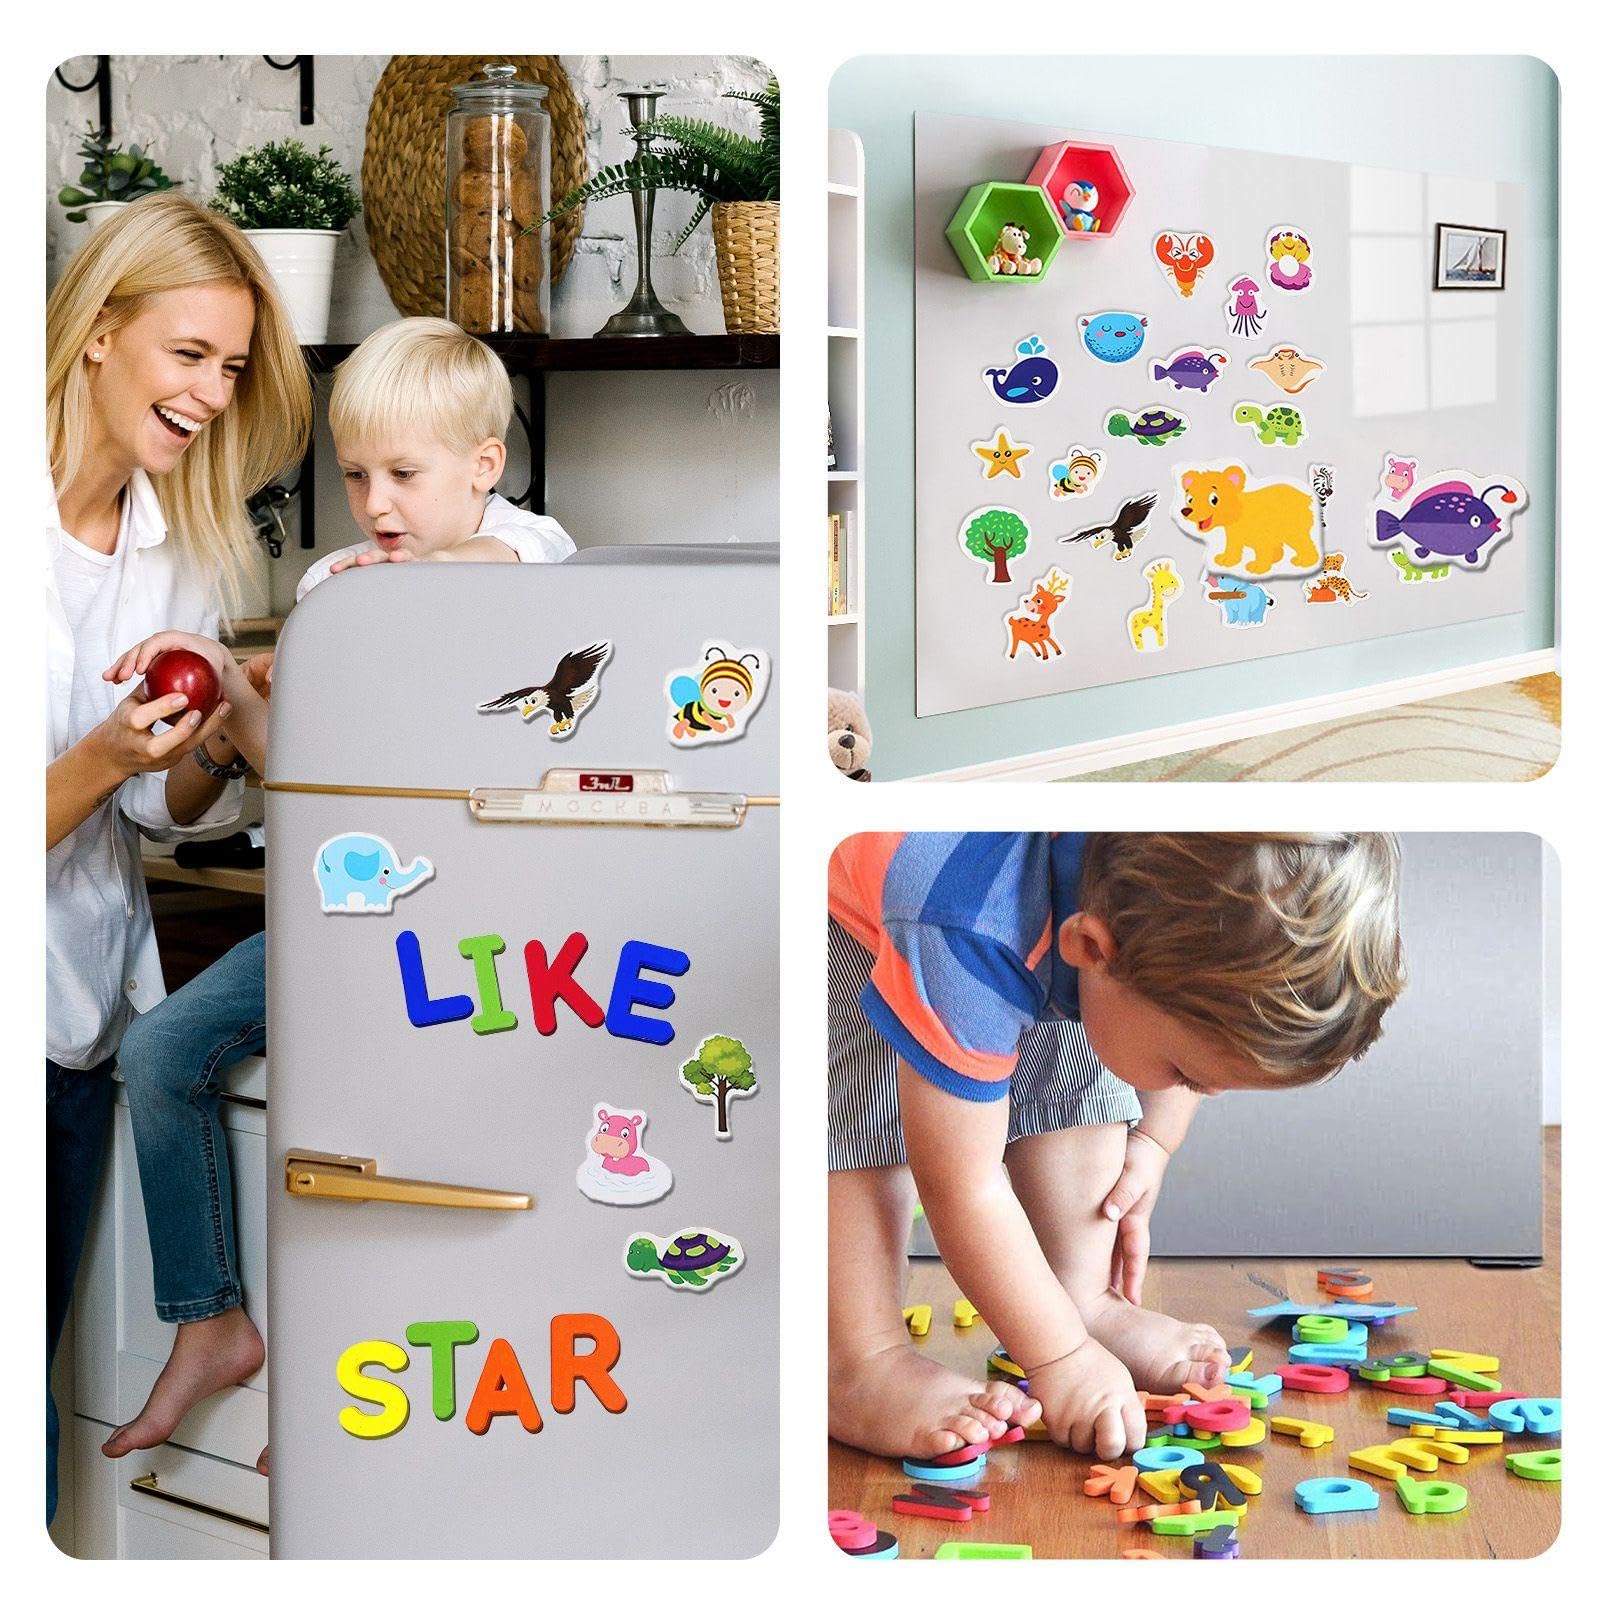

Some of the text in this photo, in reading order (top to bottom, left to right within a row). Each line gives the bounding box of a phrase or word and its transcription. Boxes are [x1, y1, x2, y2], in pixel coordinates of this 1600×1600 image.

[537, 799, 673, 817] МОСКВА
[396, 930, 690, 1046] LIKE
[336, 1313, 628, 1440] STAR
